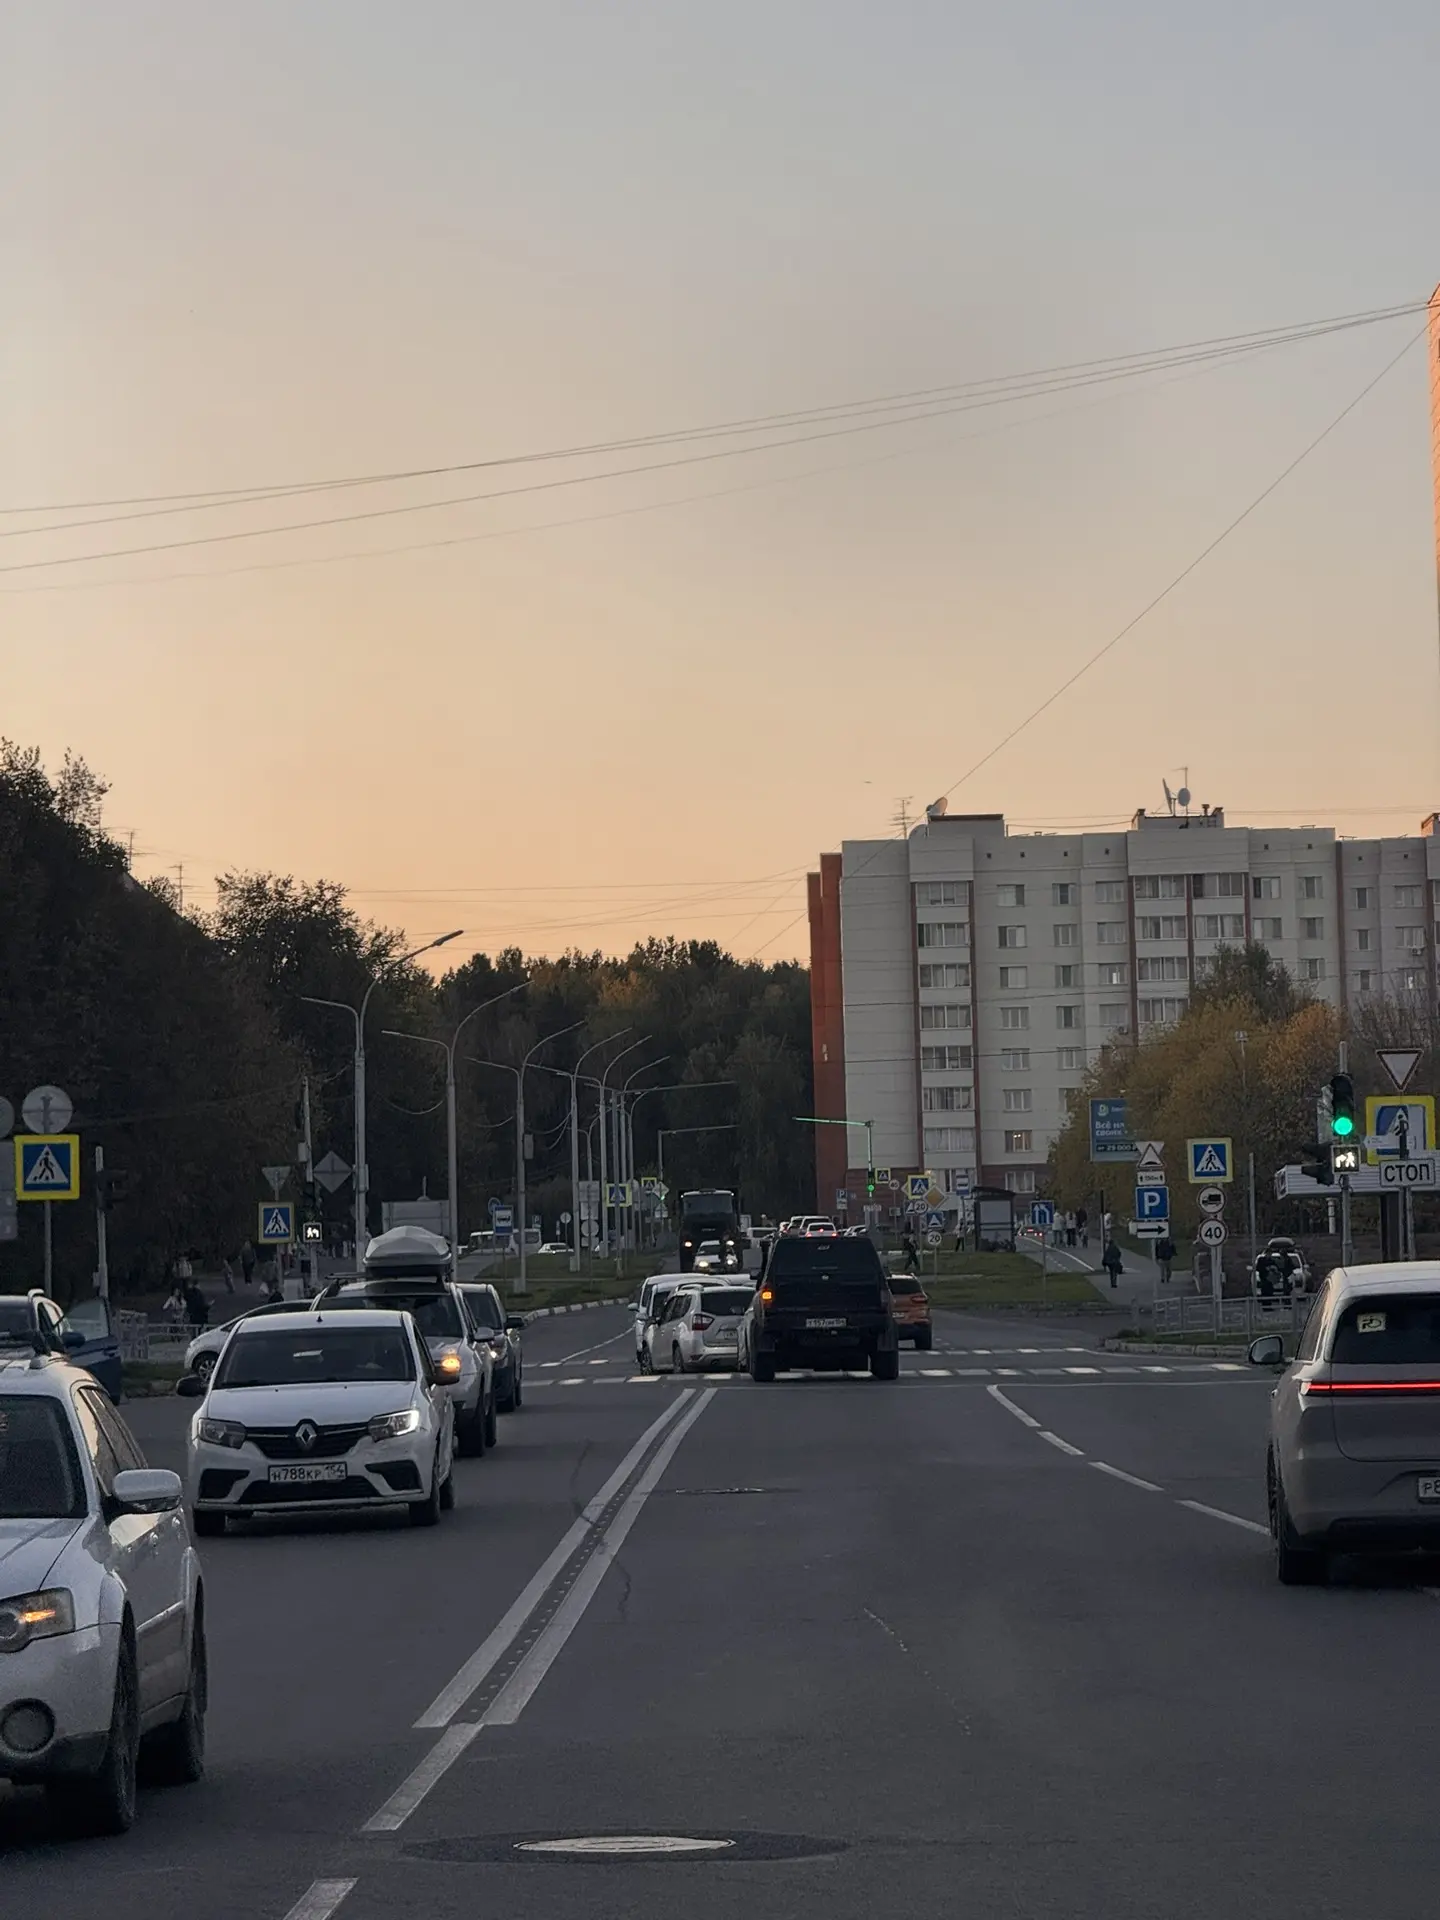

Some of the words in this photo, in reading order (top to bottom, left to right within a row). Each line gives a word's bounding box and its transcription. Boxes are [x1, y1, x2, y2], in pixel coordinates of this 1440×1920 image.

[1384, 1163, 1430, 1182] СТОП
[1144, 1192, 1160, 1215] P
[929, 1234, 941, 1243] 20
[1204, 1226, 1222, 1239] 40
